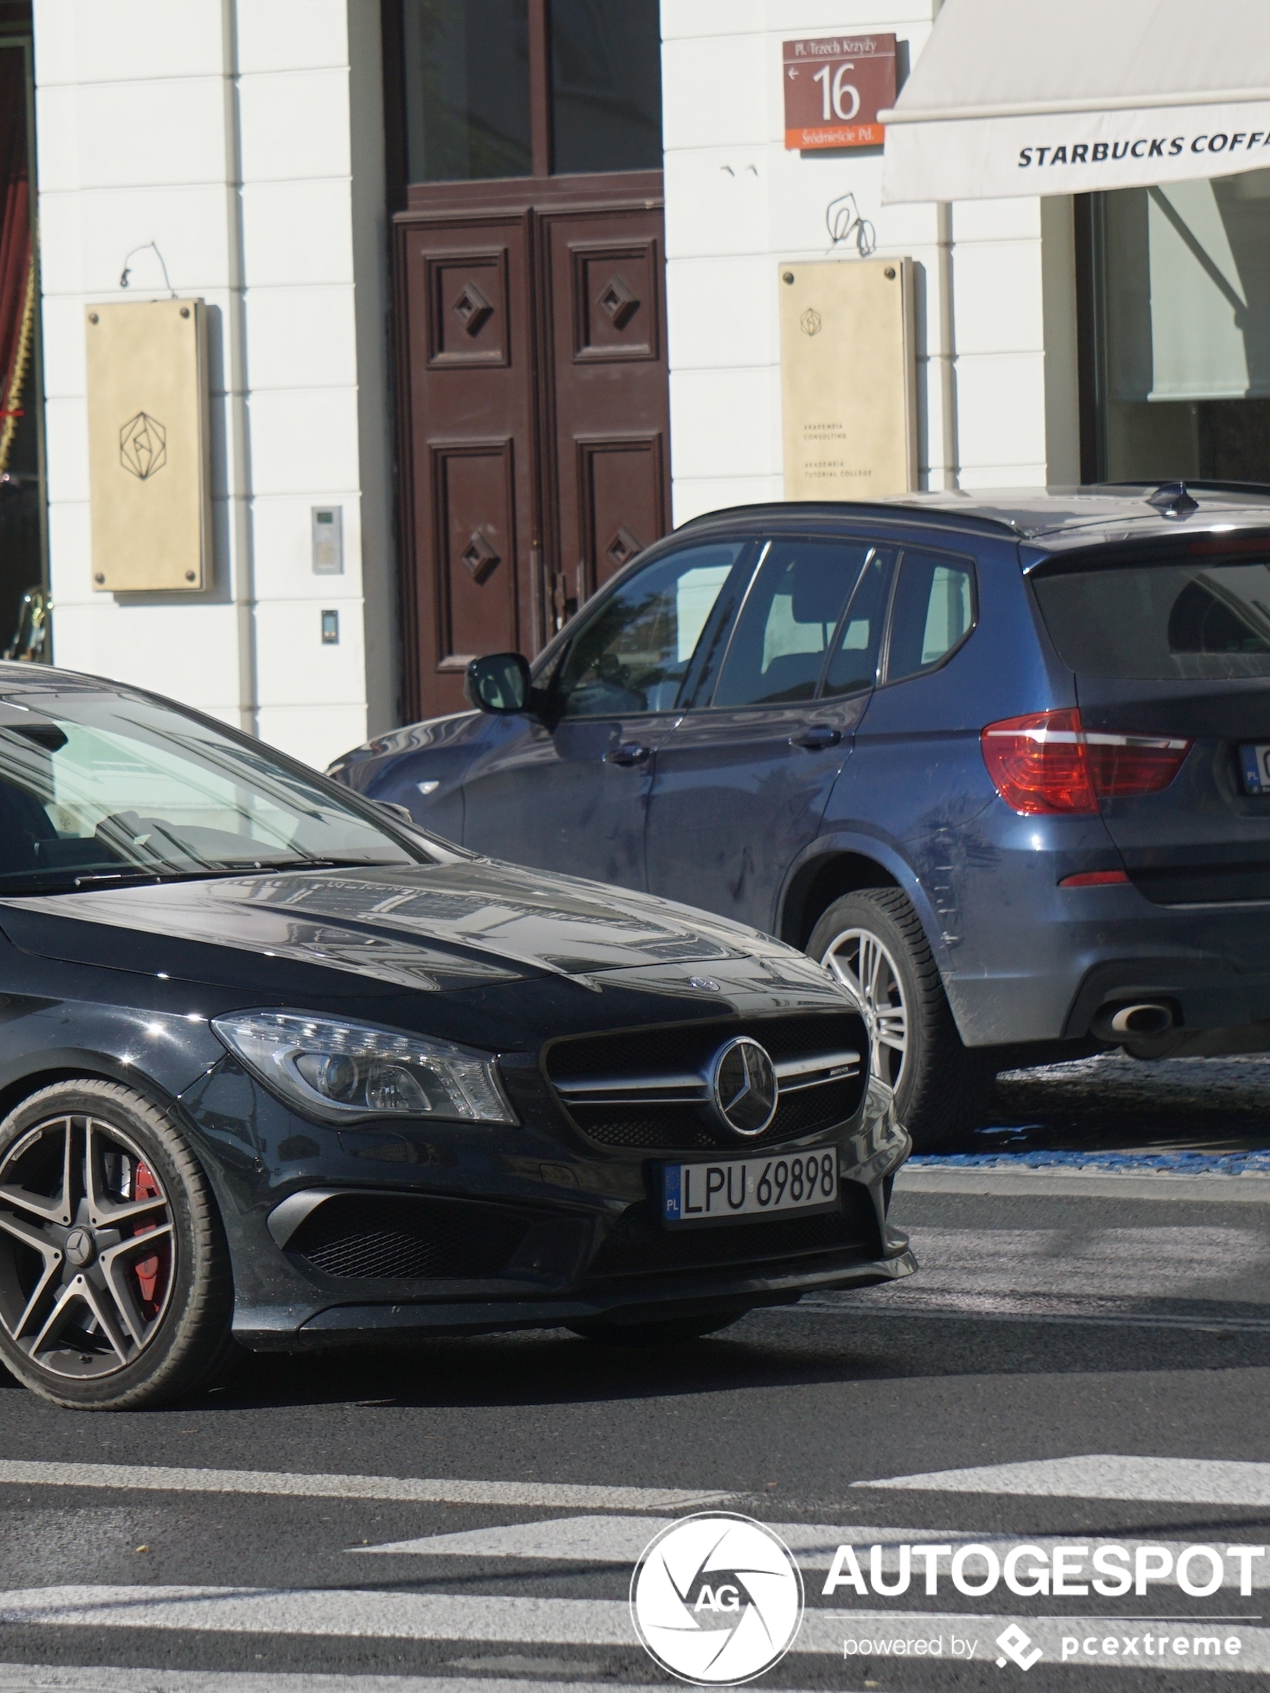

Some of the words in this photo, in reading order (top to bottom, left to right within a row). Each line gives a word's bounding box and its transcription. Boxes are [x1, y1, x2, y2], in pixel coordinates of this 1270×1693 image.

[794, 43, 807, 56] Pl.
[810, 41, 840, 55] Trzech
[843, 39, 877, 55] Krzyży
[813, 62, 860, 120] 16
[801, 129, 856, 145] Śródmieście
[858, 127, 874, 141] Pd.
[1018, 137, 1185, 168] STARBUCKS
[803, 433, 847, 441] CONSULTING
[840, 469, 872, 477] COLLEGE
[1246, 771, 1259, 780] PL
[685, 1165, 746, 1213] LPU
[756, 1153, 834, 1207] 69898
[666, 1199, 679, 1211] PL
